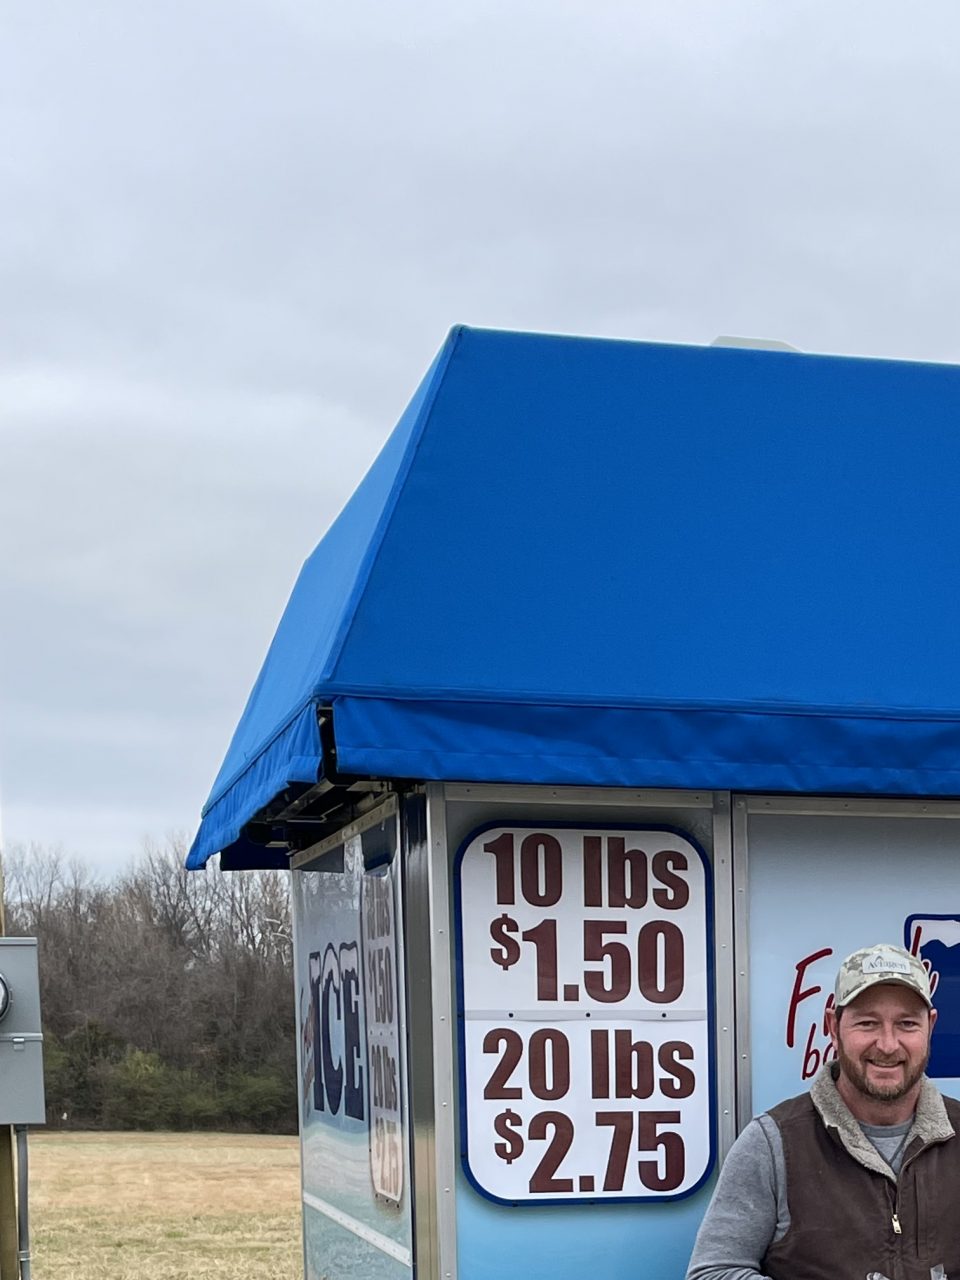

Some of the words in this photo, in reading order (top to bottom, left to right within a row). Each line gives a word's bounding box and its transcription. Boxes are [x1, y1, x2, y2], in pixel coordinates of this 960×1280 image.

[484, 833, 563, 907] 10
[583, 835, 690, 911] lbs
[489, 913, 685, 1004] $1.50
[308, 940, 365, 1122] ICE
[482, 1028, 571, 1101] 20
[591, 1028, 697, 1100] lbs
[493, 1108, 686, 1194] $2.75
